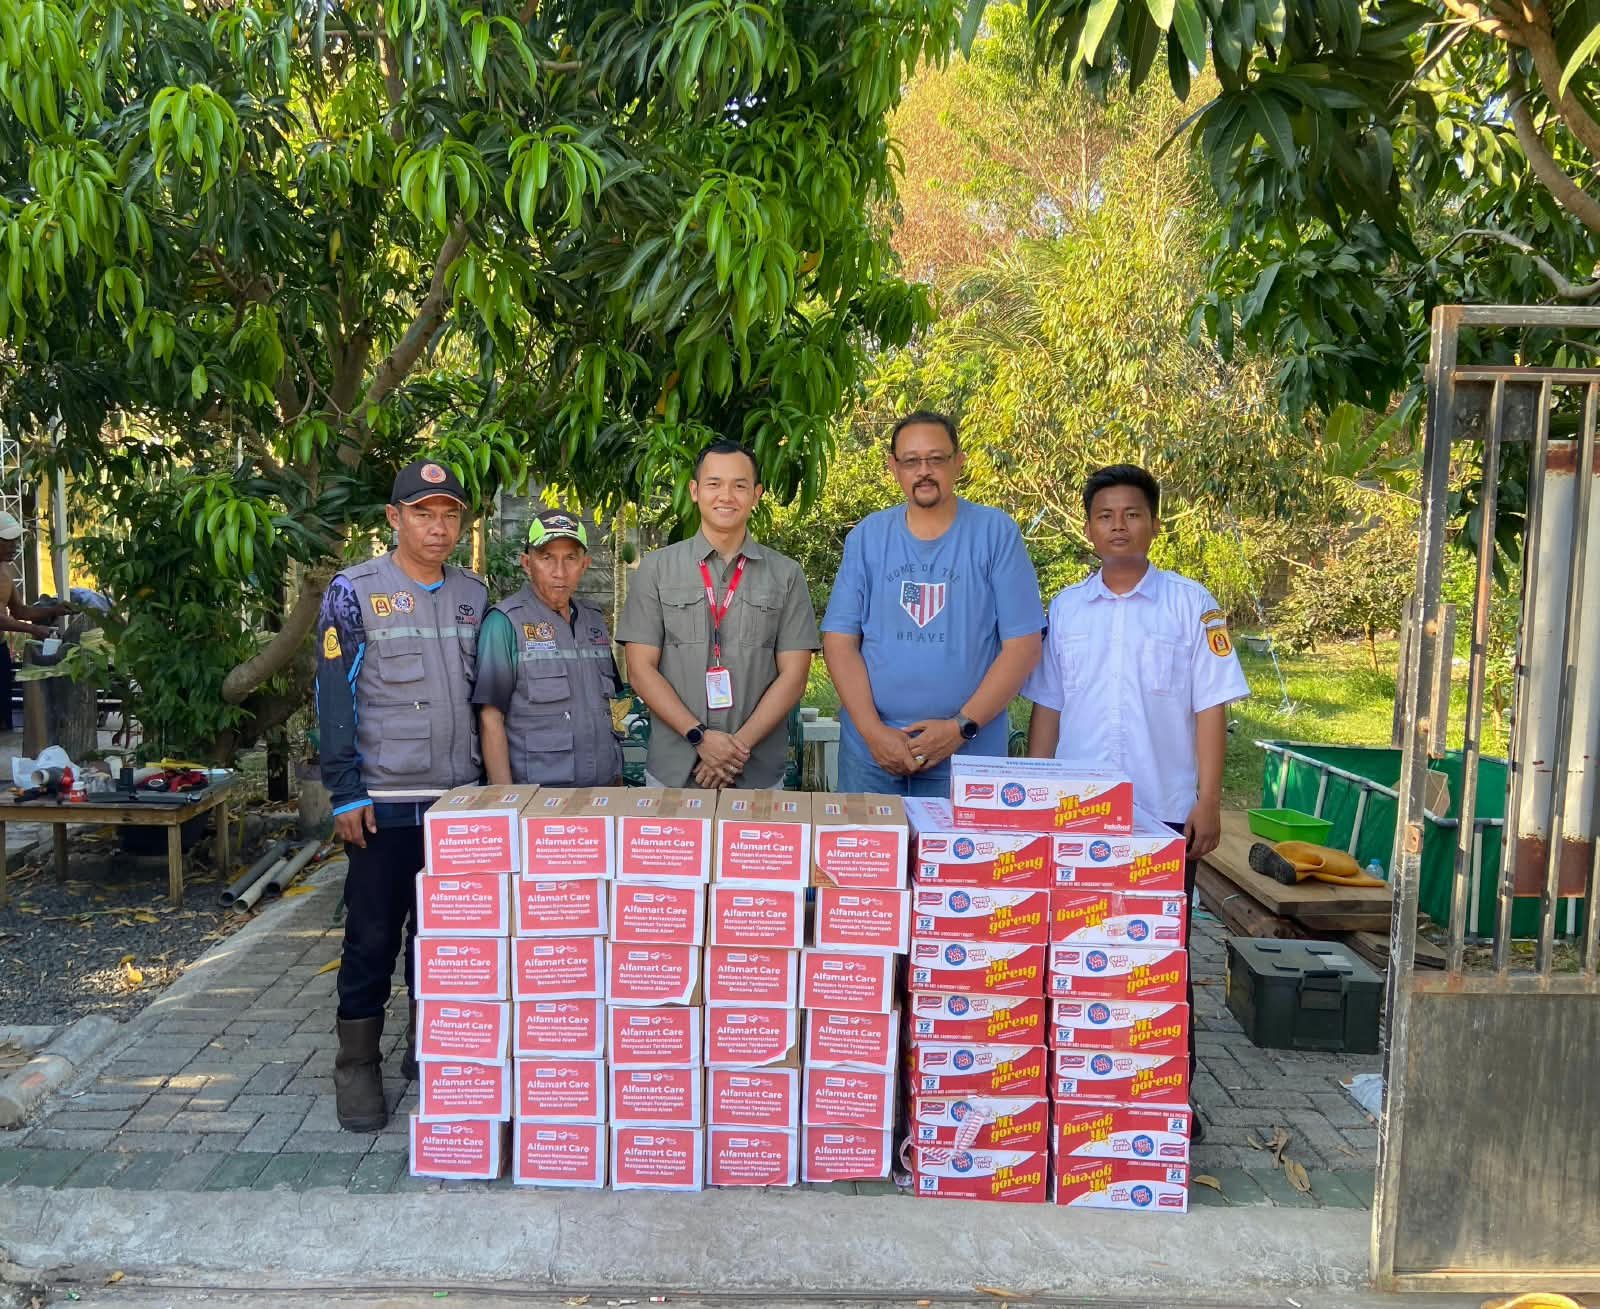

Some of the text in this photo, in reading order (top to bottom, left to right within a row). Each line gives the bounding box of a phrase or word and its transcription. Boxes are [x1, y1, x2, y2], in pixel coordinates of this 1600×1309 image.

[1054, 801, 1111, 826] goreng
[439, 835, 502, 846] Alfamart Care
[535, 837, 575, 845] Alfamart
[631, 838, 671, 846] Alfamart
[730, 842, 770, 850] Alfamart
[827, 849, 867, 858] Alfamart
[993, 857, 1043, 880] goreng
[1129, 859, 1180, 882] goreng
[430, 893, 469, 901] Alfamart
[528, 893, 567, 901] Alfamart
[624, 904, 664, 913] Alfamart
[723, 908, 764, 917] Alfamart
[830, 908, 869, 916] Alfamart
[1056, 898, 1107, 921] goreng
[989, 912, 1040, 934] goreng
[525, 957, 564, 965] Alfamart
[619, 963, 658, 971] Alfamart
[718, 964, 757, 973] Alfamart
[813, 972, 852, 981] Alfamart
[986, 966, 1036, 987] goreng
[1127, 970, 1179, 993] goreng
[430, 1019, 470, 1028] Alfamart
[988, 1014, 1038, 1036] goreng
[621, 1027, 660, 1035] Alfamart
[717, 1025, 756, 1034] Alfamart
[819, 1026, 858, 1035] Alfamart
[1130, 1024, 1181, 1046] goreng
[992, 1065, 1040, 1088] goreng
[527, 1079, 566, 1088] Alfamart
[1131, 1073, 1182, 1096] goreng
[720, 1088, 759, 1097] Alfamart
[816, 1088, 854, 1098] Alfamart
[1063, 1112, 1113, 1136] goreng
[1172, 1120, 1183, 1128] 12
[991, 1120, 1041, 1142] goreng
[422, 1136, 461, 1144] Alfamart
[527, 1142, 566, 1151] Alfamart
[814, 1145, 853, 1154] Alfamart
[624, 1146, 686, 1157] Alfamart Care
[719, 1149, 758, 1158] Alfamart
[1062, 1164, 1112, 1186] goreng
[992, 1172, 1040, 1194] goreng
